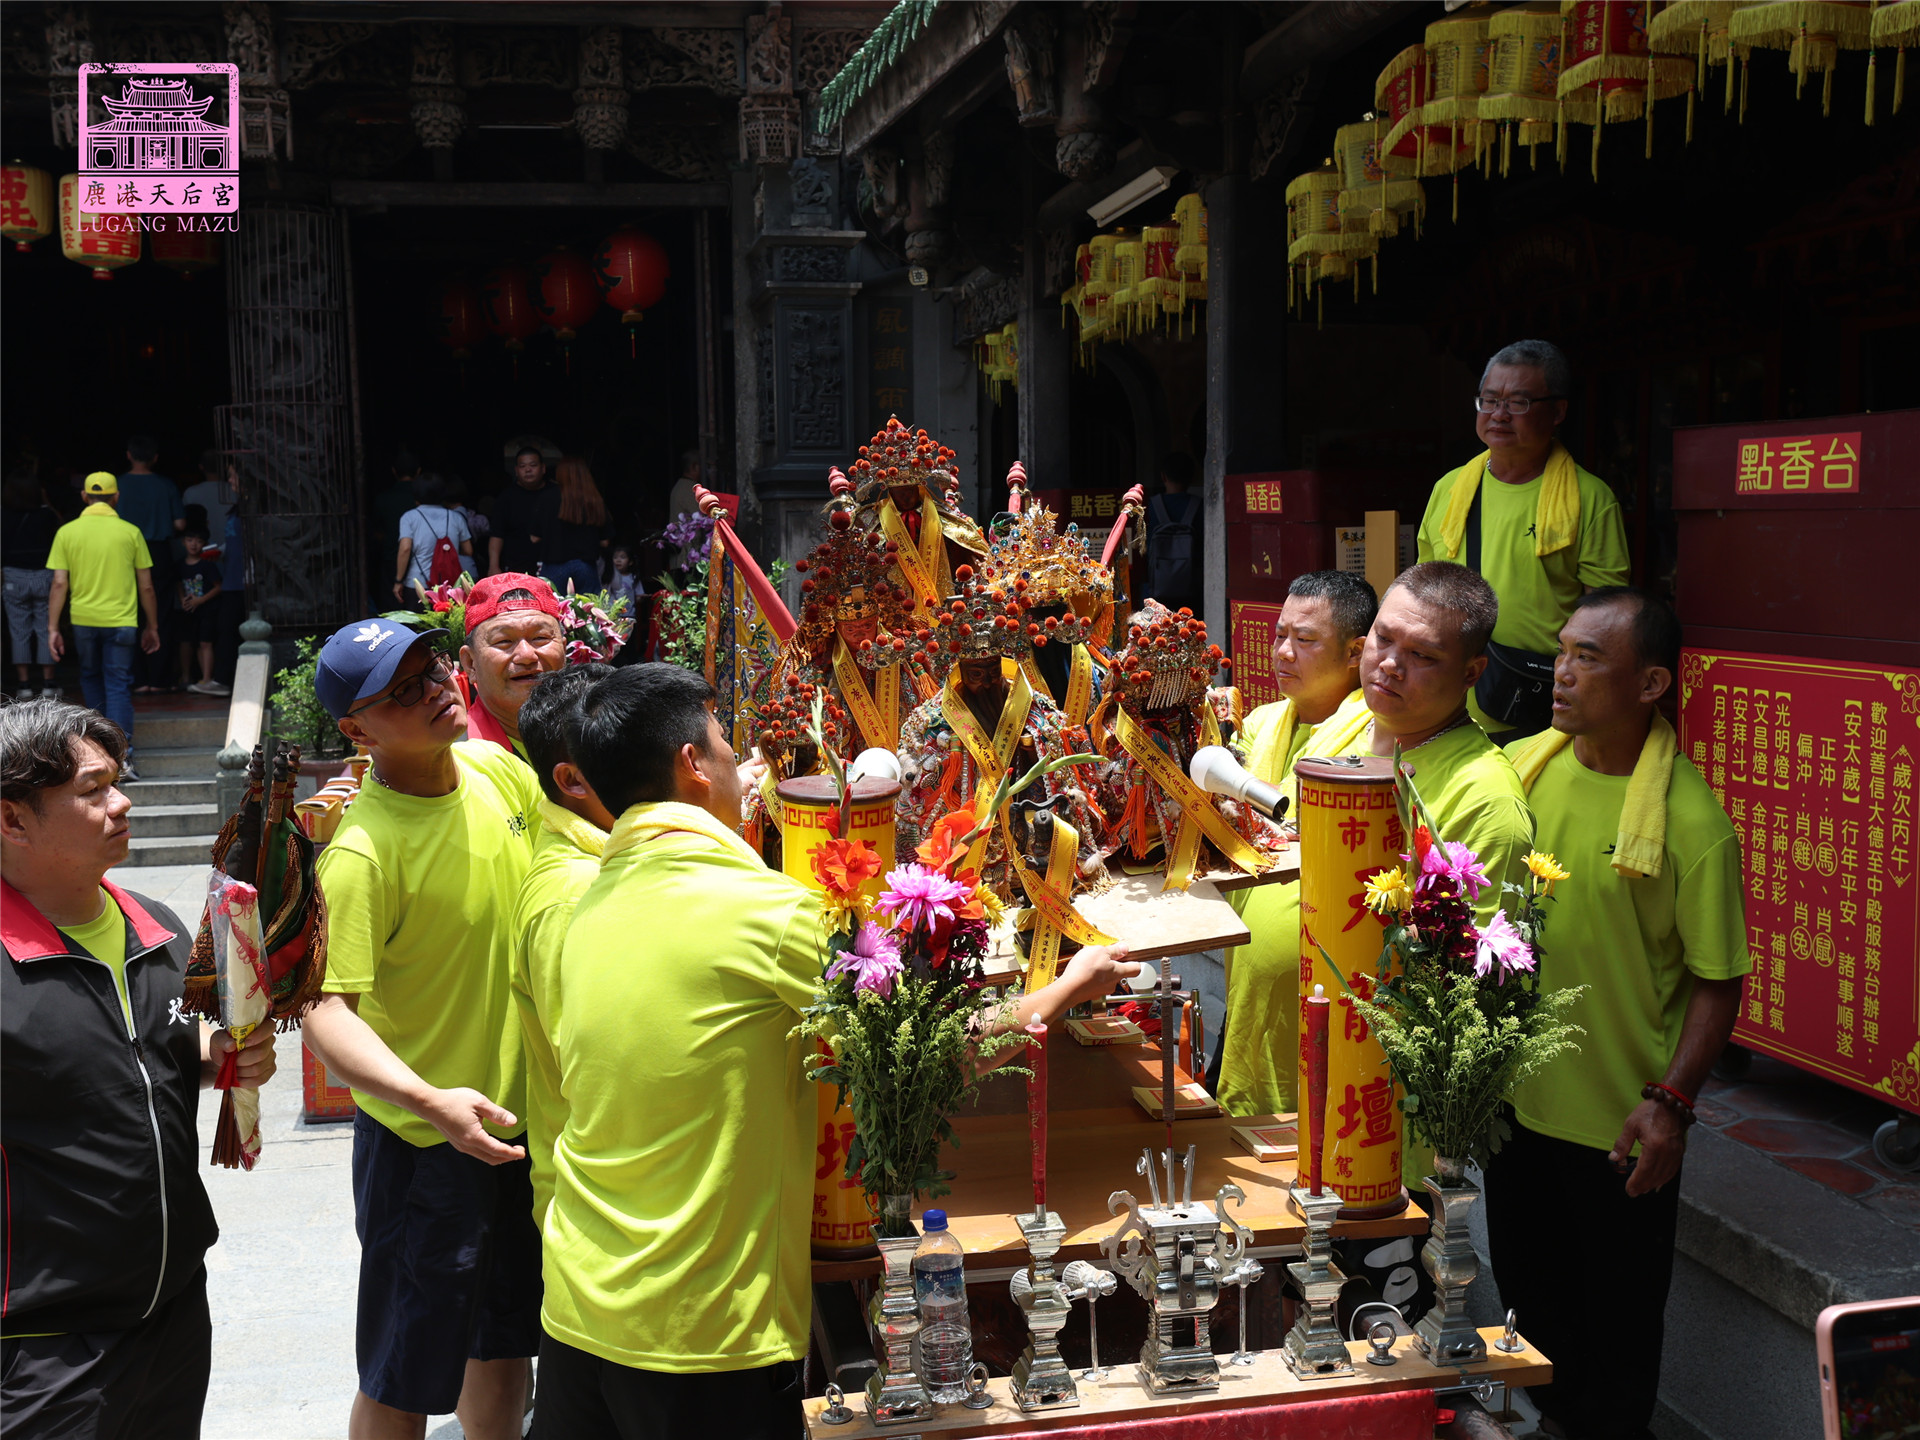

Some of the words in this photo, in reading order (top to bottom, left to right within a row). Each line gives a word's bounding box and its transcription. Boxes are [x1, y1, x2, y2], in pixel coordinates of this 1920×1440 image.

[1738, 438, 1858, 493] 點香台
[1071, 494, 1122, 518] 點香
[1246, 483, 1281, 512] 點香台
[368, 630, 395, 651] adidas
[1147, 752, 1188, 796] 鹿港天后宮
